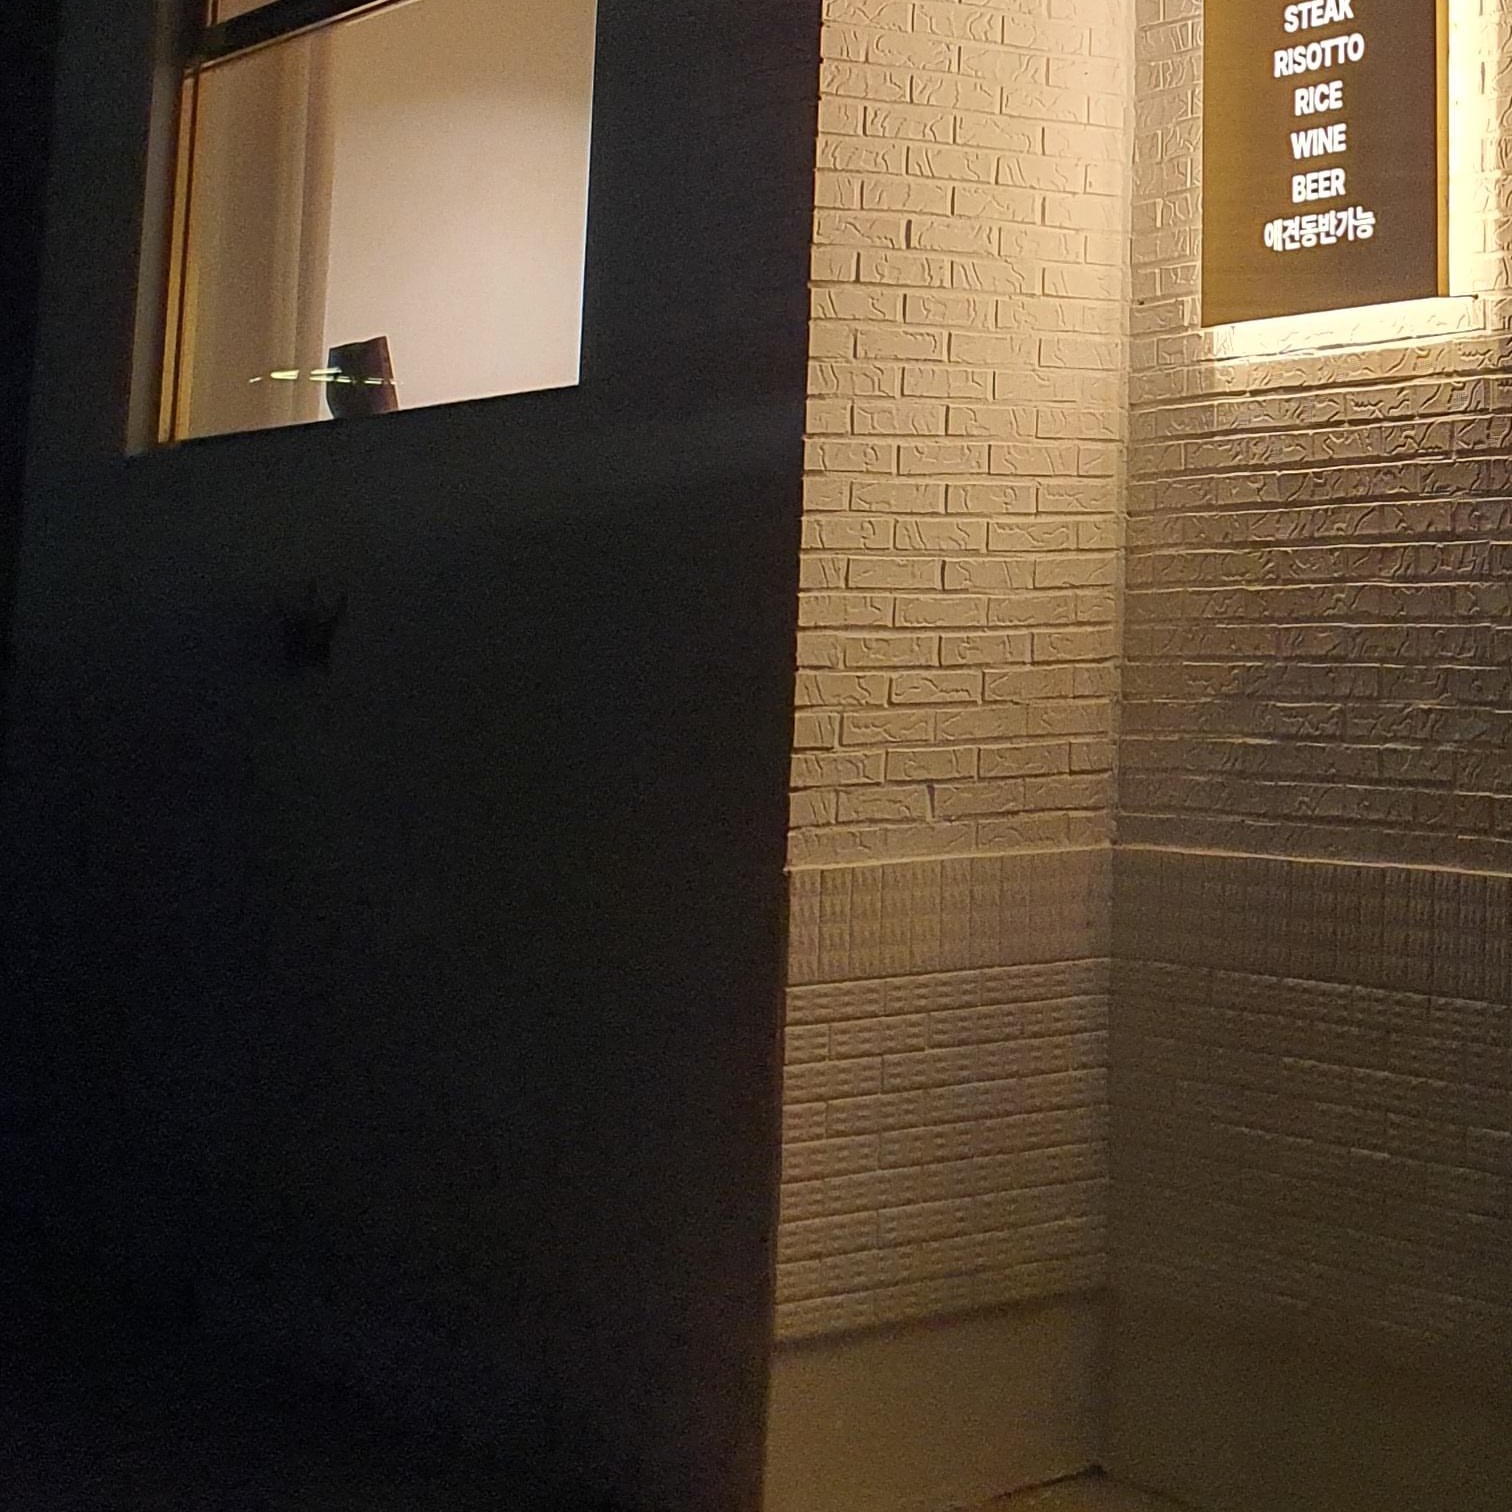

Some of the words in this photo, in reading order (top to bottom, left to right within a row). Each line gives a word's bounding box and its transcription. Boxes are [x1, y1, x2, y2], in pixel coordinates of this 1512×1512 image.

[1273, 33, 1365, 78] RISOTTO
[1294, 81, 1343, 117] RICE
[1291, 123, 1347, 160] WINE
[1292, 167, 1346, 203] BEER
[1263, 205, 1376, 252] 애견동반가능
